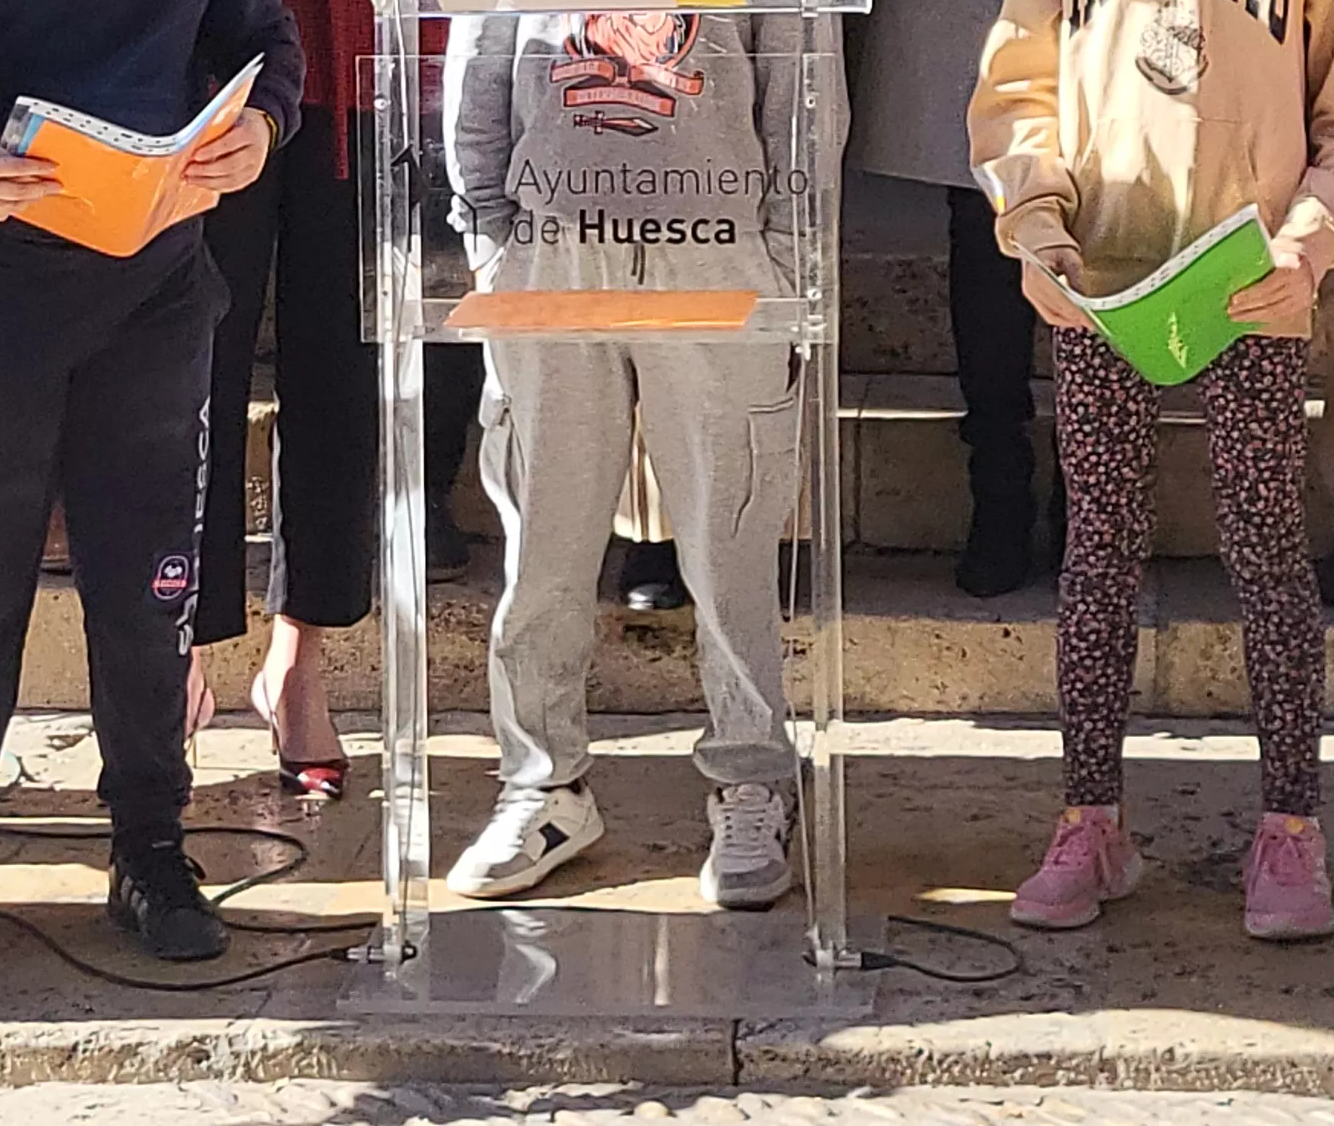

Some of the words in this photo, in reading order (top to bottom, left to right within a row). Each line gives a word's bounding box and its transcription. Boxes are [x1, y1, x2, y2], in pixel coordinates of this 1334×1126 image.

[514, 158, 808, 206] Ayuntamiento
[514, 208, 560, 245] de
[579, 208, 737, 245] Huesca
